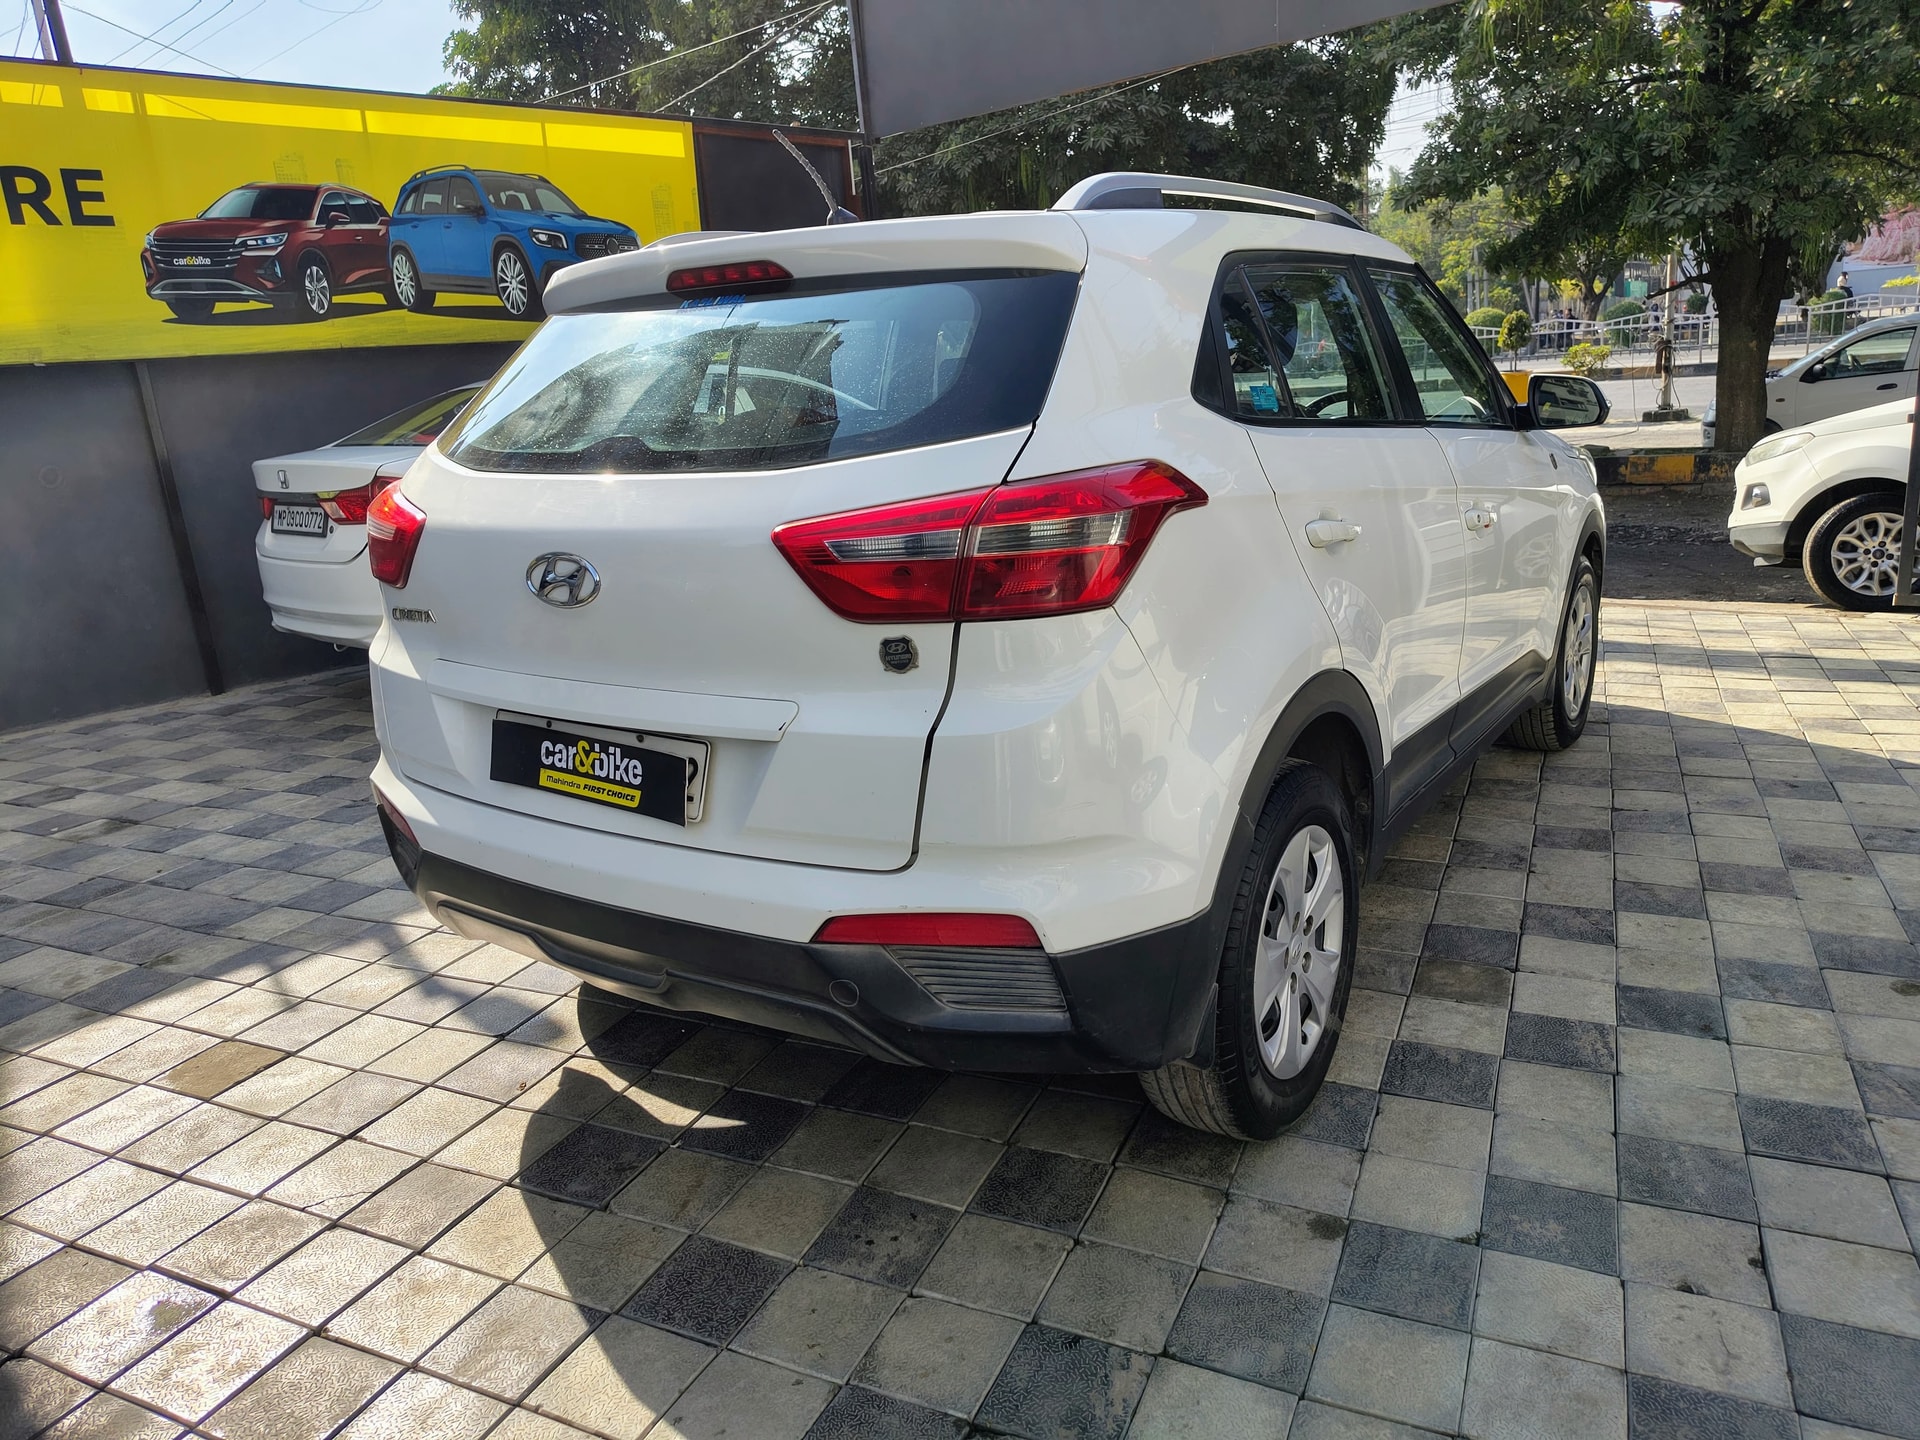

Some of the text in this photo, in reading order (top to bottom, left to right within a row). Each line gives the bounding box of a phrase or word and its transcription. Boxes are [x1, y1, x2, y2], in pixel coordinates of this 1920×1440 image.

[0, 165, 116, 226] RE
[540, 740, 643, 785] car&bike
[546, 774, 636, 803] Mahindra FIRST CHOICE
